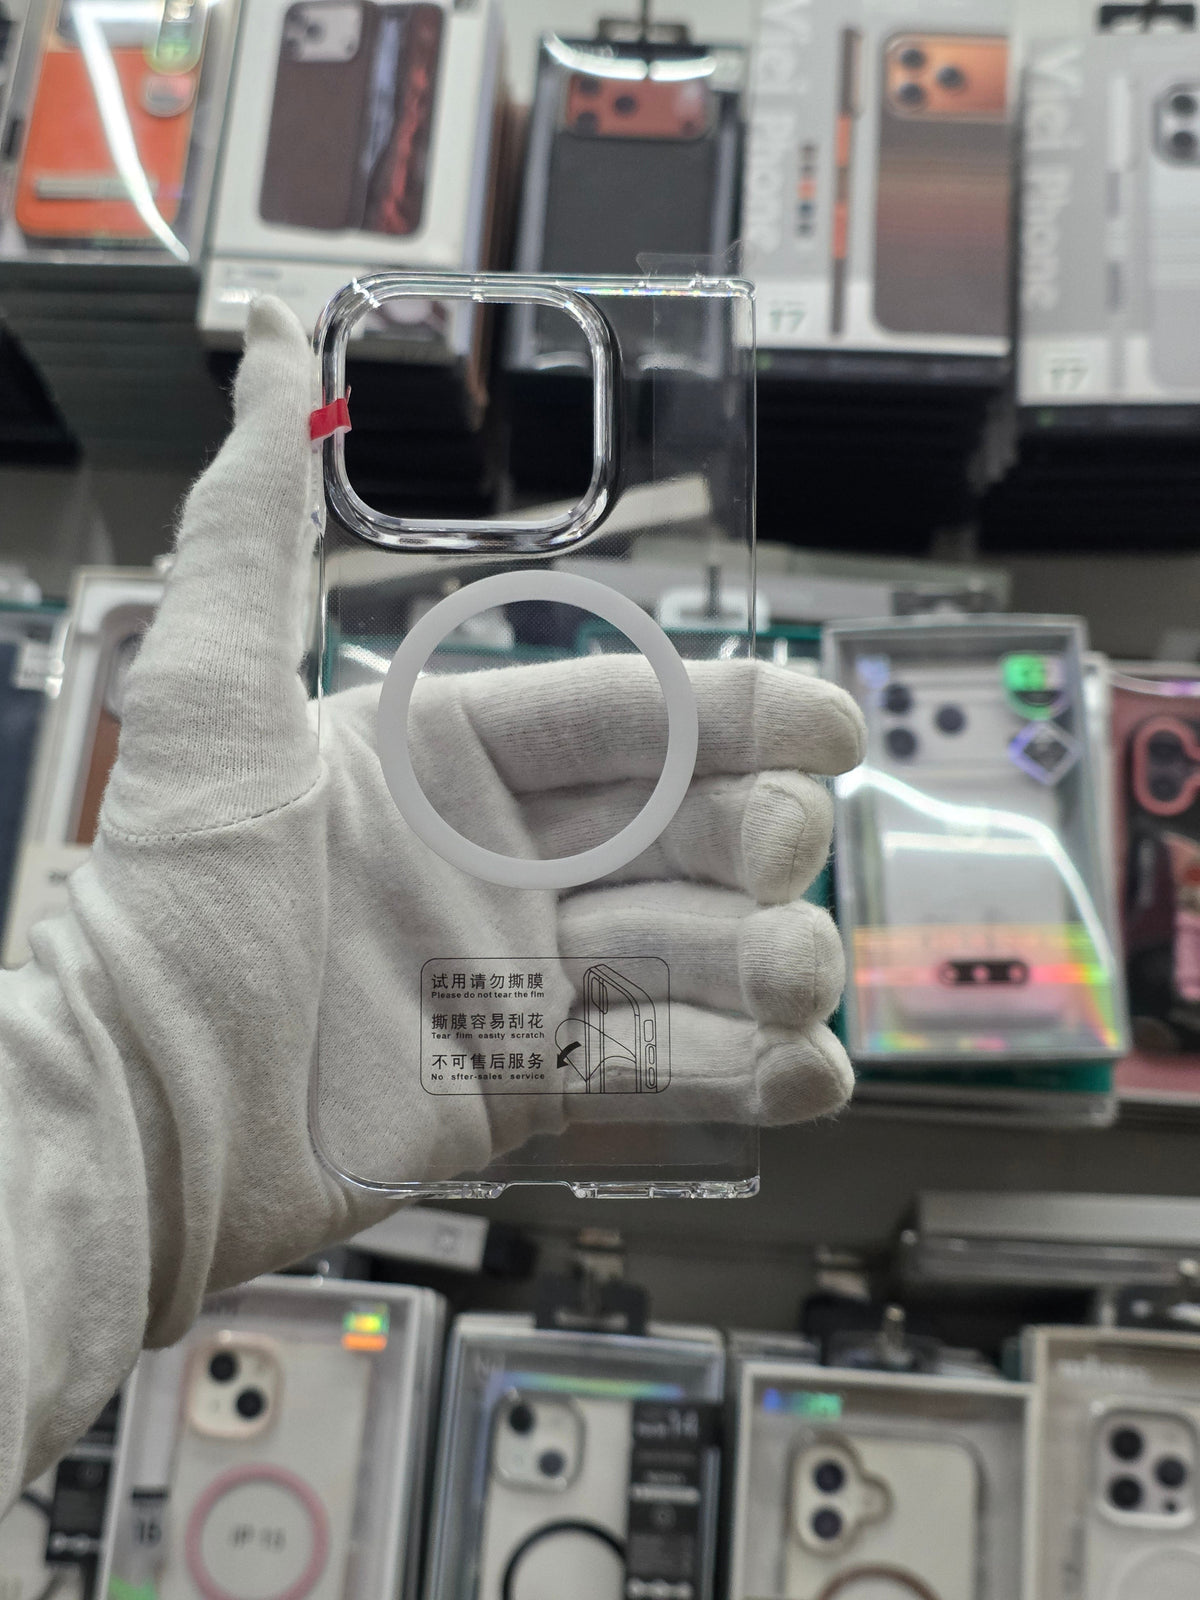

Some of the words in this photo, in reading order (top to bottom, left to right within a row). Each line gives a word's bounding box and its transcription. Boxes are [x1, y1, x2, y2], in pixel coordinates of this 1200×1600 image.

[769, 309, 808, 333] 17
[431, 973, 544, 989] 试用请勿撕膜
[431, 991, 461, 999] Please
[463, 991, 475, 999] do
[477, 991, 492, 999] not
[494, 991, 512, 999] tear
[514, 990, 528, 998] the
[431, 1013, 544, 1029] 撕膜容易刮花
[455, 1031, 473, 1039] film
[510, 1031, 545, 1039] scratch
[431, 1053, 544, 1070] 不可售后服务
[510, 1072, 545, 1080] service
